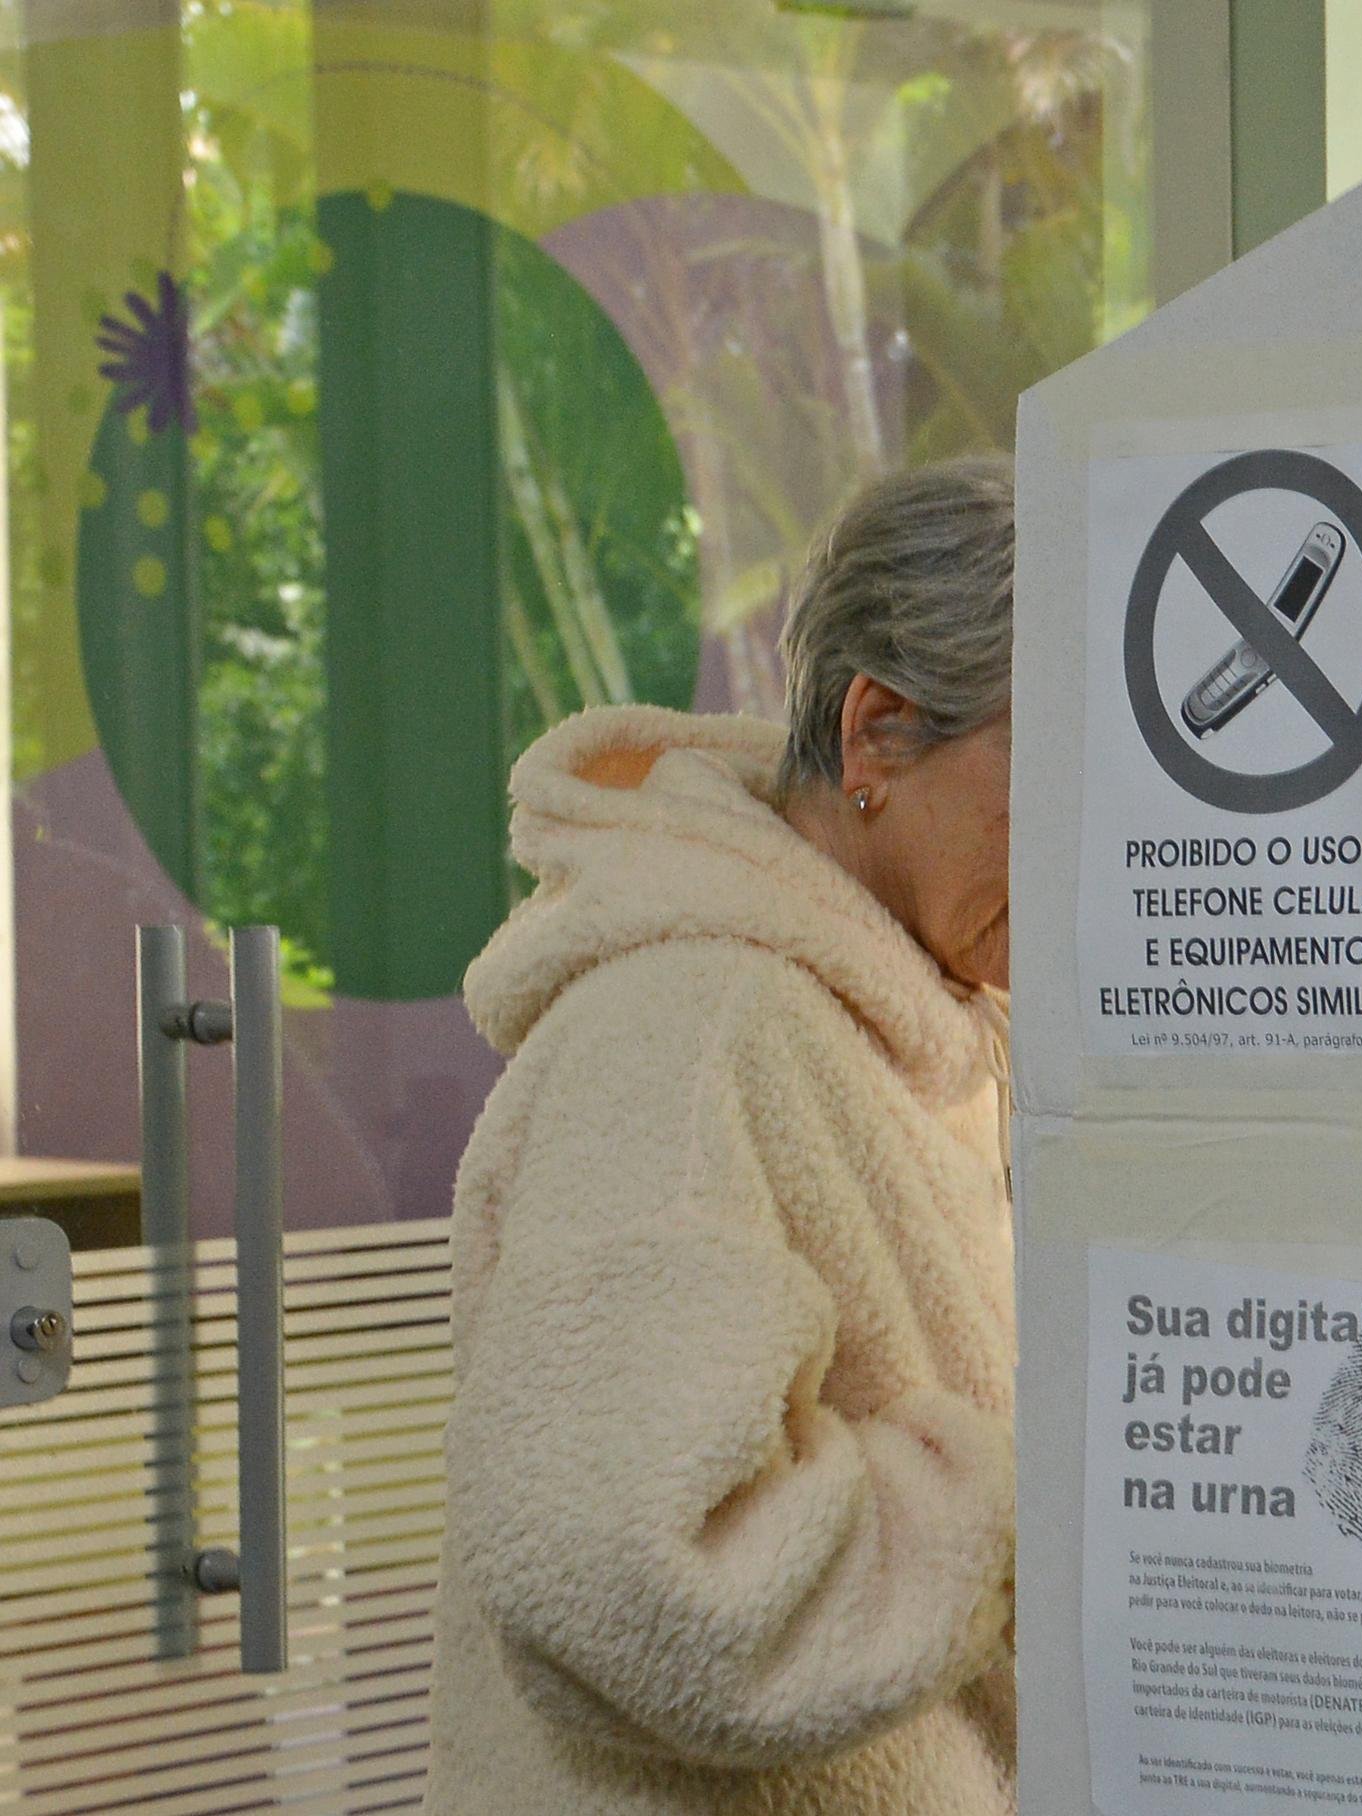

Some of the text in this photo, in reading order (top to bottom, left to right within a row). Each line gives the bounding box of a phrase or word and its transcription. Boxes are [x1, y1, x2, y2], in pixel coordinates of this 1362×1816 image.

[1126, 836, 1256, 868] PROIBIDO
[1267, 837, 1292, 866] O
[1303, 835, 1361, 865] USO
[1133, 886, 1263, 918] TELEFONE
[1146, 938, 1159, 966] E
[1099, 978, 1288, 1017] ELETRÔNICOS
[1131, 1032, 1151, 1047] Lei
[1171, 1033, 1233, 1048] 9.504/97,
[1238, 1034, 1260, 1047] art.
[1265, 1033, 1299, 1047] 91-A,
[1303, 1033, 1362, 1051] parágrafo
[1126, 1294, 1210, 1338] Sua
[1122, 1352, 1291, 1406] já pode
[1124, 1413, 1242, 1455] estar
[1123, 1476, 1296, 1518] na urna
[1129, 1550, 1141, 1564] Se
[1195, 1556, 1242, 1570] cadastrou
[1245, 1560, 1262, 1572] sua
[1263, 1560, 1313, 1576] biometria
[1143, 1573, 1175, 1590] Justiça
[1178, 1575, 1218, 1590] Eleitoral
[1309, 1587, 1332, 1600] para
[1156, 1597, 1179, 1610] para
[1205, 1599, 1239, 1612] colocar
[1130, 1637, 1153, 1652] Você
[1155, 1639, 1181, 1654] pode
[1182, 1643, 1198, 1654] ser
[1200, 1642, 1237, 1658] alguém
[1308, 1651, 1351, 1667] eleitores
[1131, 1658, 1148, 1672] Rio
[1149, 1660, 1186, 1674] Grande
[1187, 1661, 1201, 1675] do
[1202, 1663, 1218, 1676] Sul
[1220, 1667, 1239, 1680] que
[1240, 1667, 1278, 1681] tiveram
[1303, 1671, 1332, 1686] dados
[1133, 1680, 1189, 1697] importados
[1191, 1683, 1204, 1698] da
[1206, 1687, 1245, 1701] carteira
[1134, 1704, 1172, 1719] carteira
[1174, 1704, 1187, 1719] de
[1189, 1706, 1244, 1723] identidade
[1246, 1710, 1277, 1728] (IGP)
[1279, 1716, 1301, 1730] para
